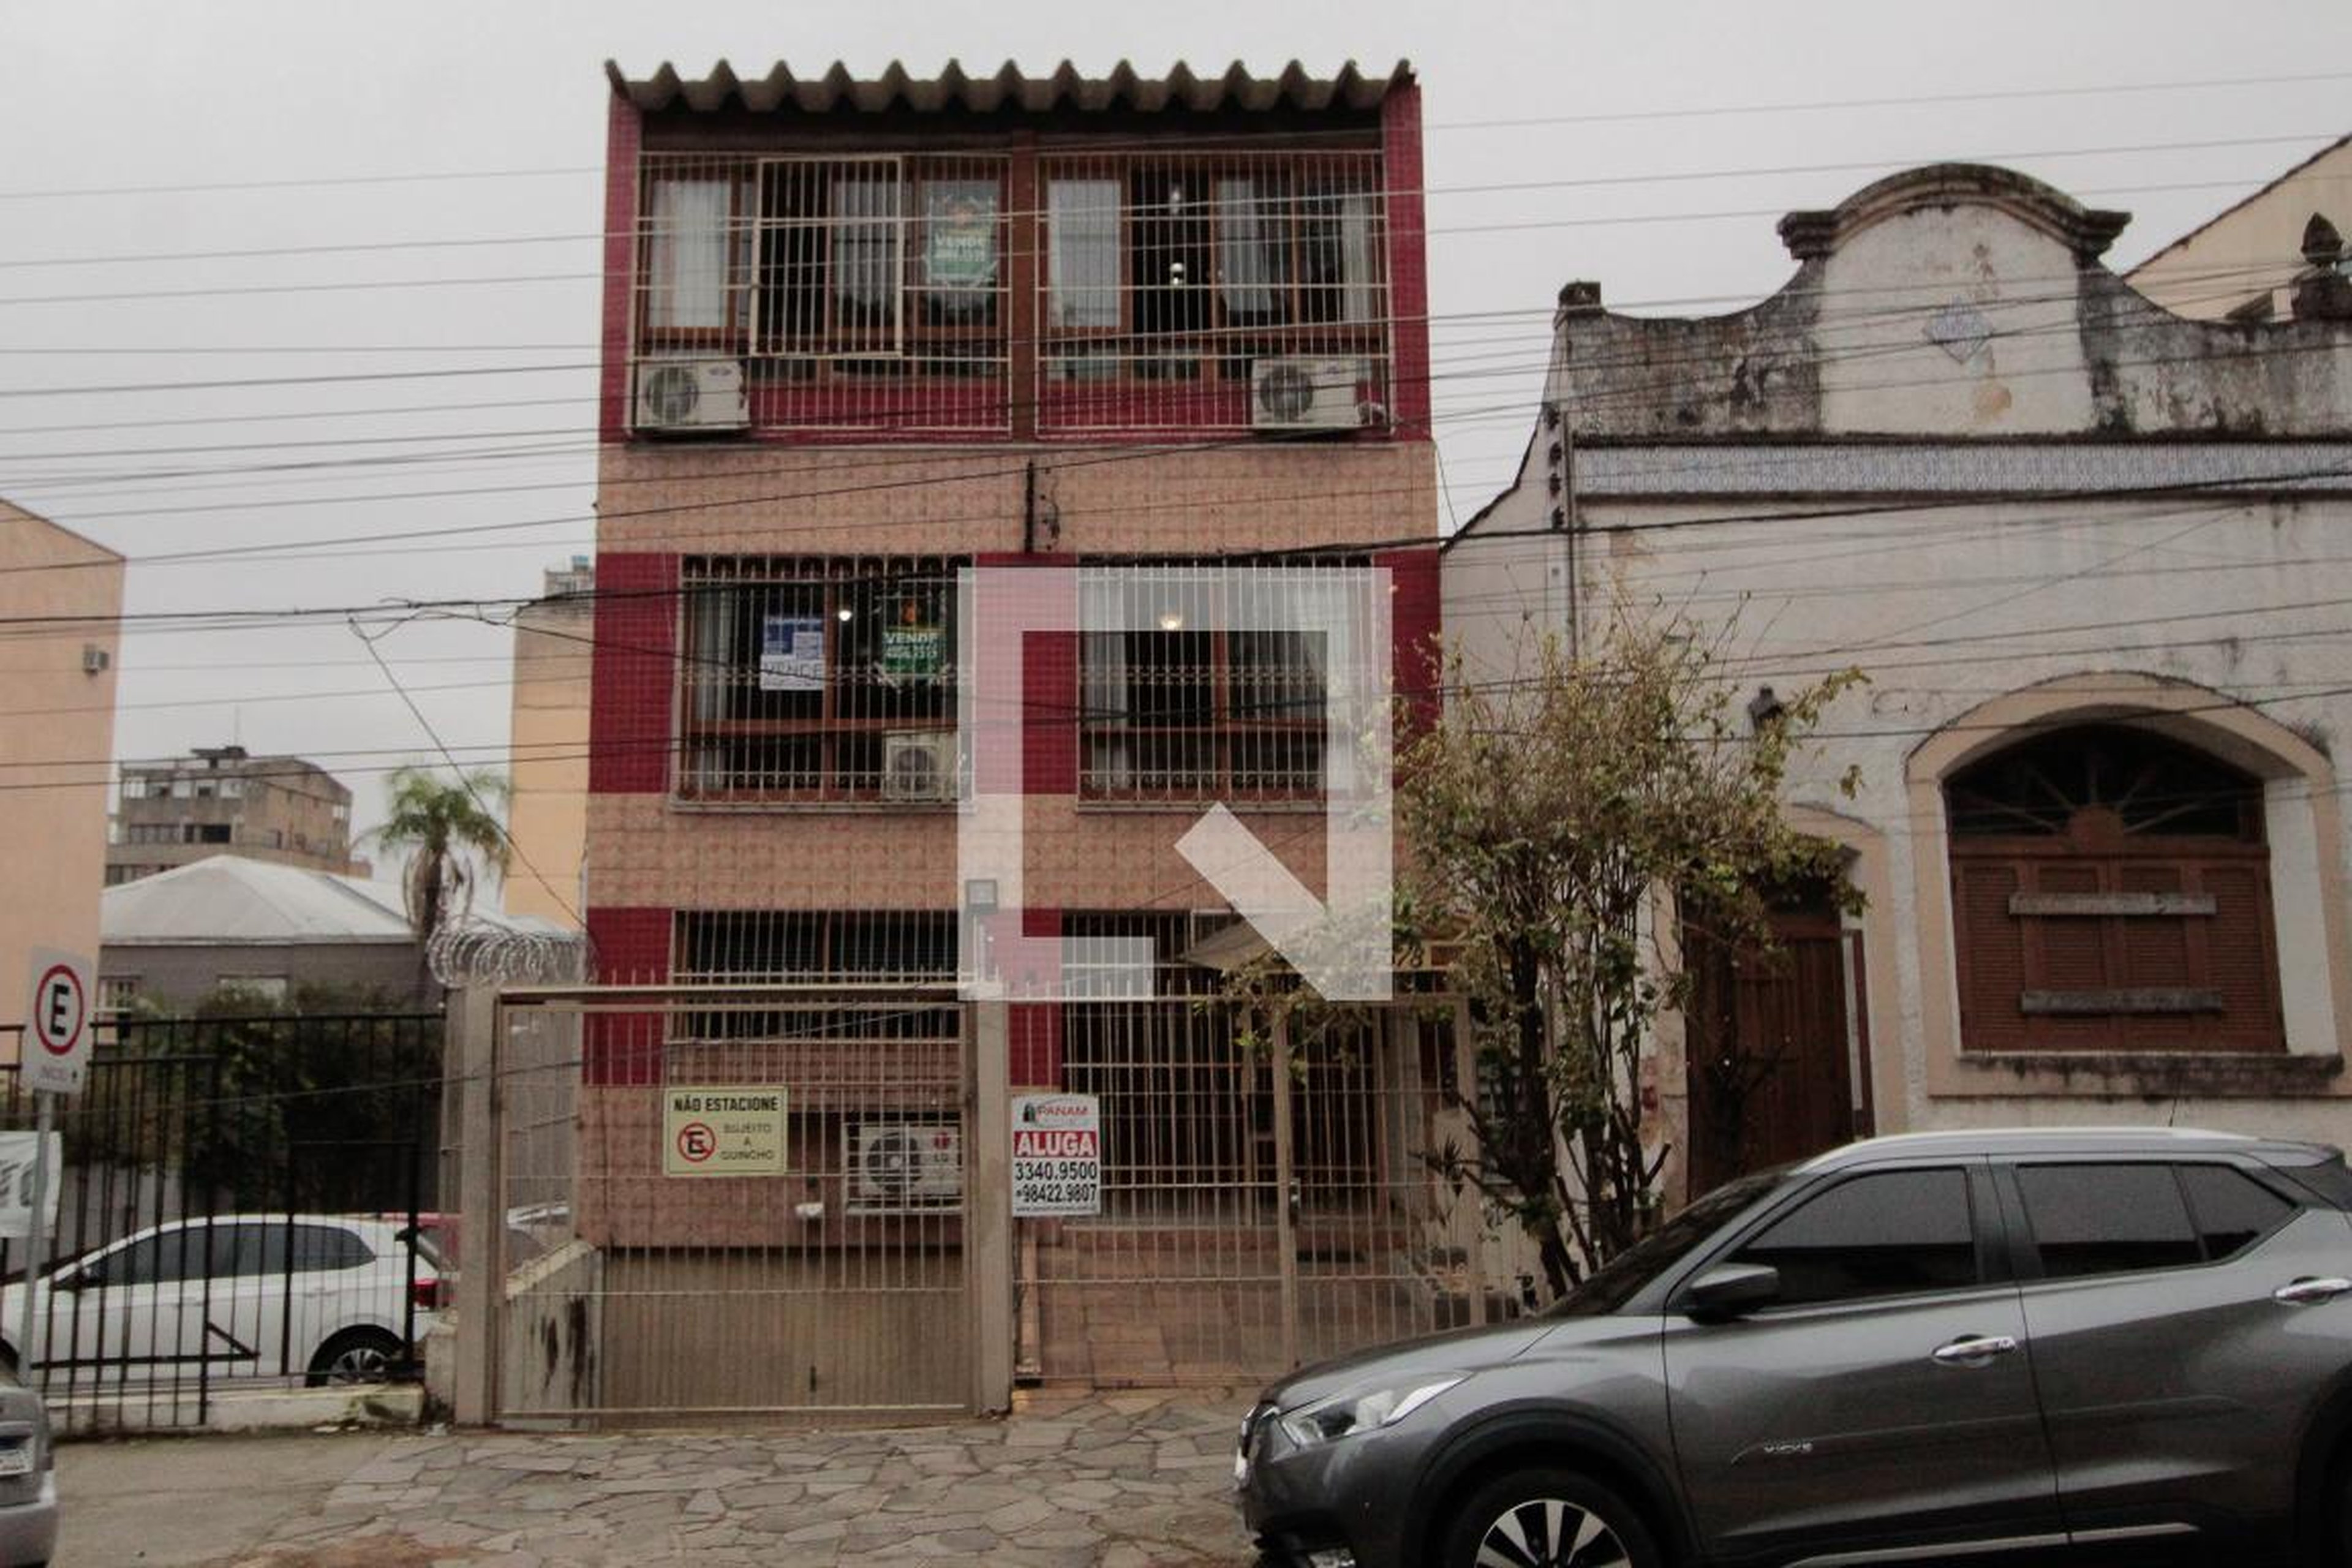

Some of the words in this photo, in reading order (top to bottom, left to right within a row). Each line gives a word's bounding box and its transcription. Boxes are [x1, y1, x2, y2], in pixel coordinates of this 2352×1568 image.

[50, 984, 70, 1036] E
[674, 1095, 701, 1111] NÃO
[706, 1097, 778, 1112] ESTACIONE
[688, 1131, 704, 1154] E
[1017, 1133, 1095, 1156] ALUGA
[720, 1150, 775, 1160] GUINCHO
[1015, 1161, 1097, 1180] 3340.9500
